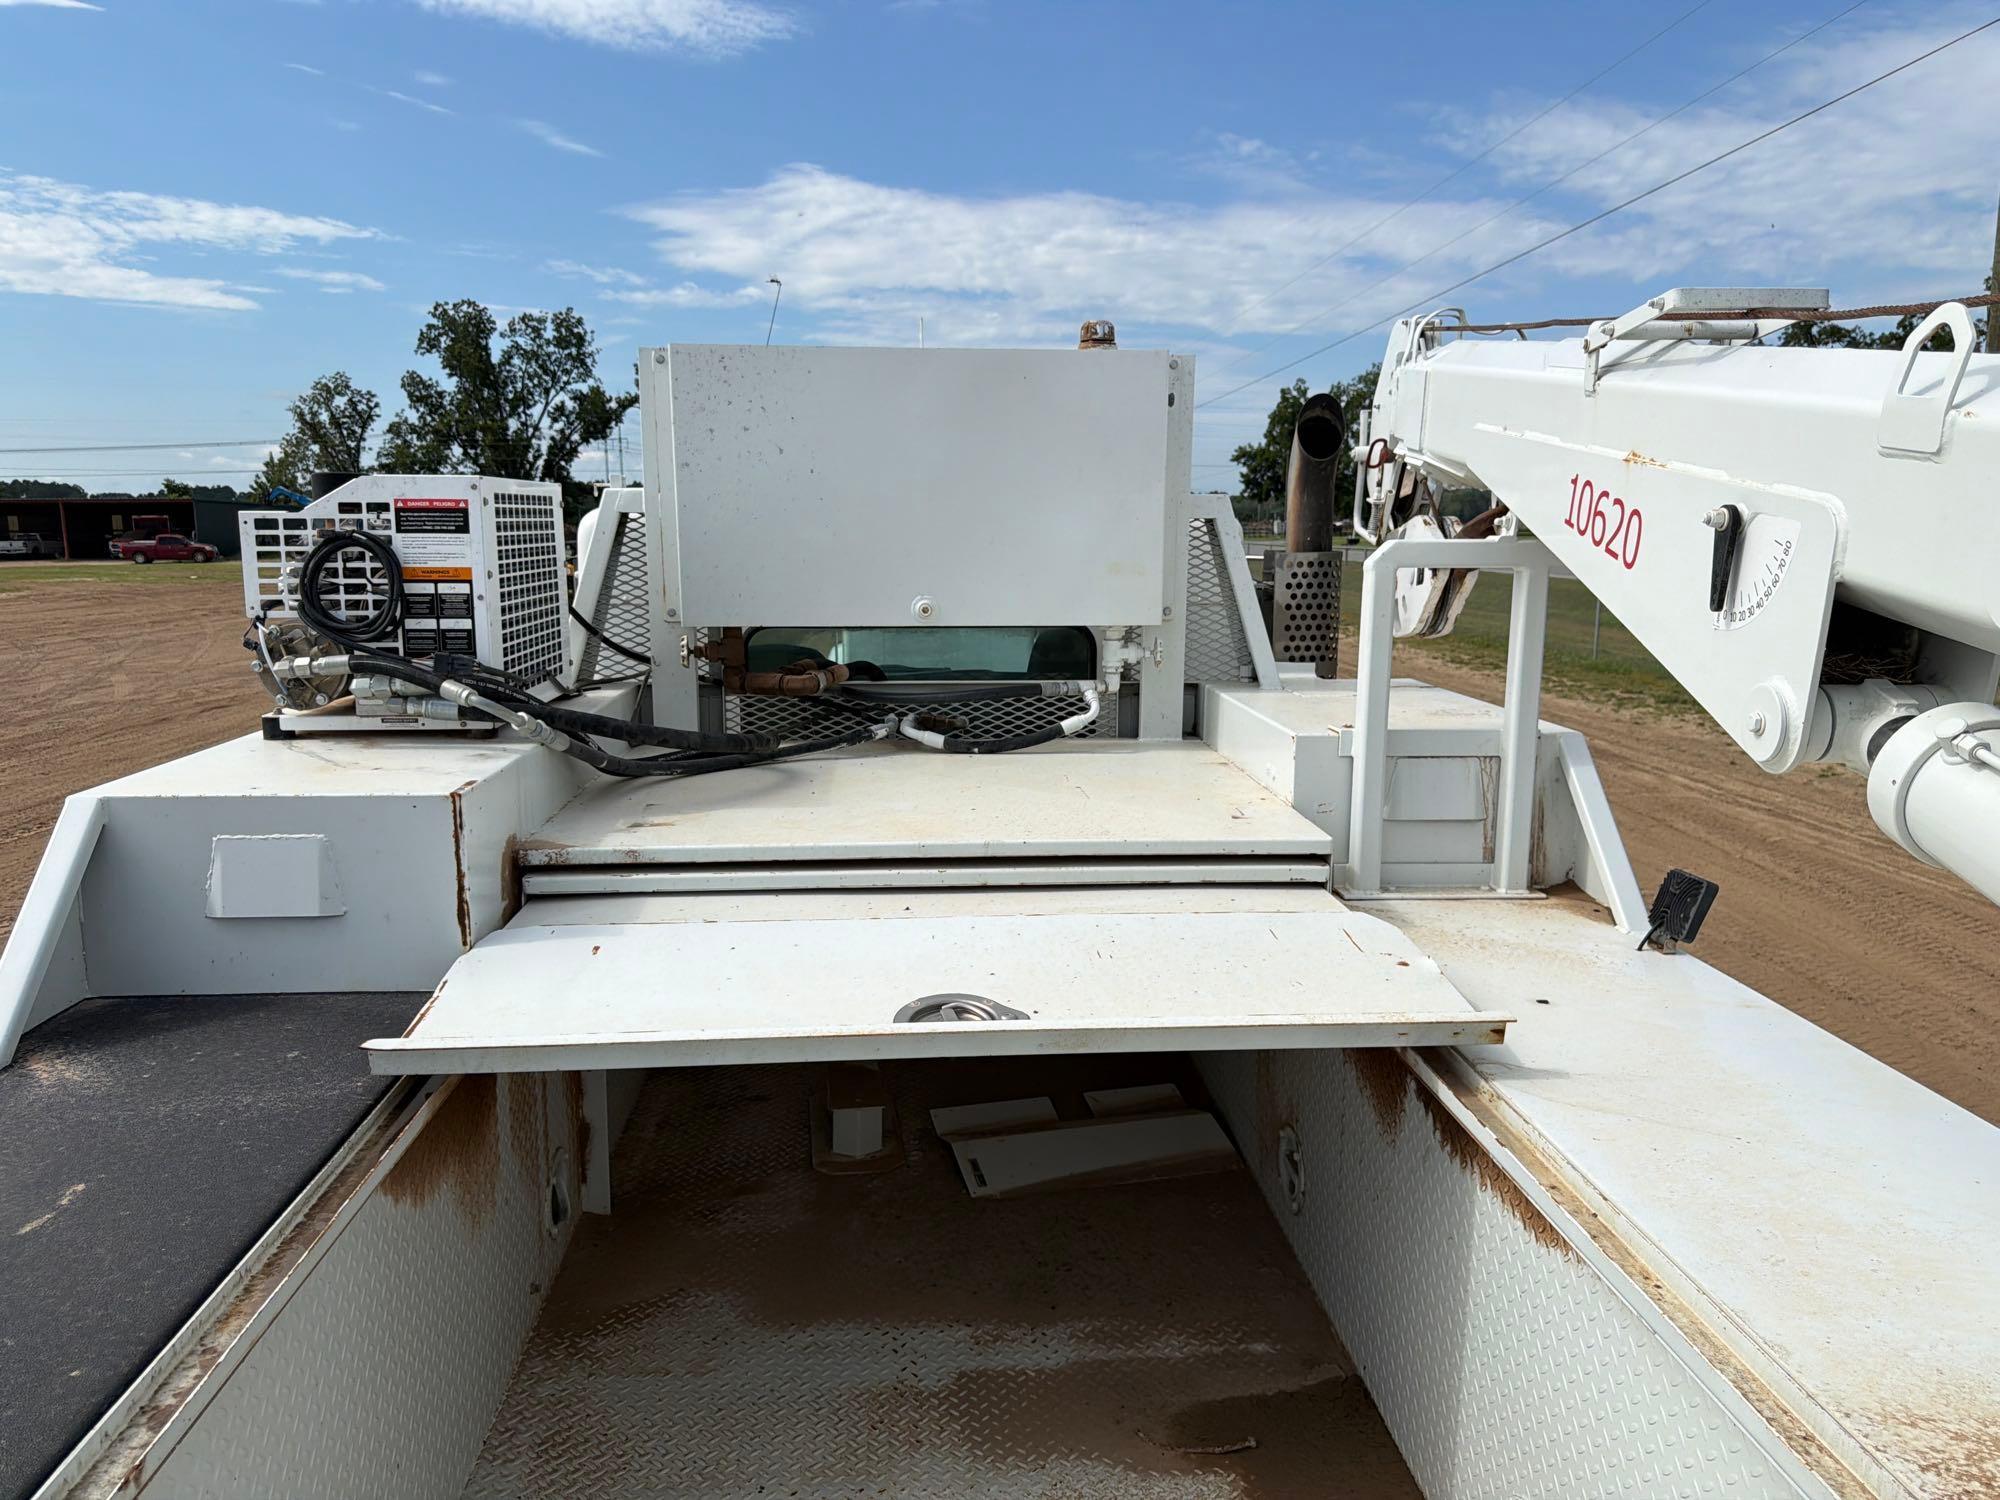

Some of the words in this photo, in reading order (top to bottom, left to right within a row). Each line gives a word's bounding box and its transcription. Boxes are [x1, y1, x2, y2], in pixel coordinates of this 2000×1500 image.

[1564, 473, 1643, 570] 10620
[1730, 611, 1737, 622] 10
[1738, 610, 1746, 622] 20
[1747, 605, 1755, 618] 30
[1756, 597, 1764, 610] 40
[1764, 585, 1773, 601] 50
[1772, 573, 1780, 588] 60
[1777, 558, 1787, 574] 70
[1783, 540, 1792, 557] 80
